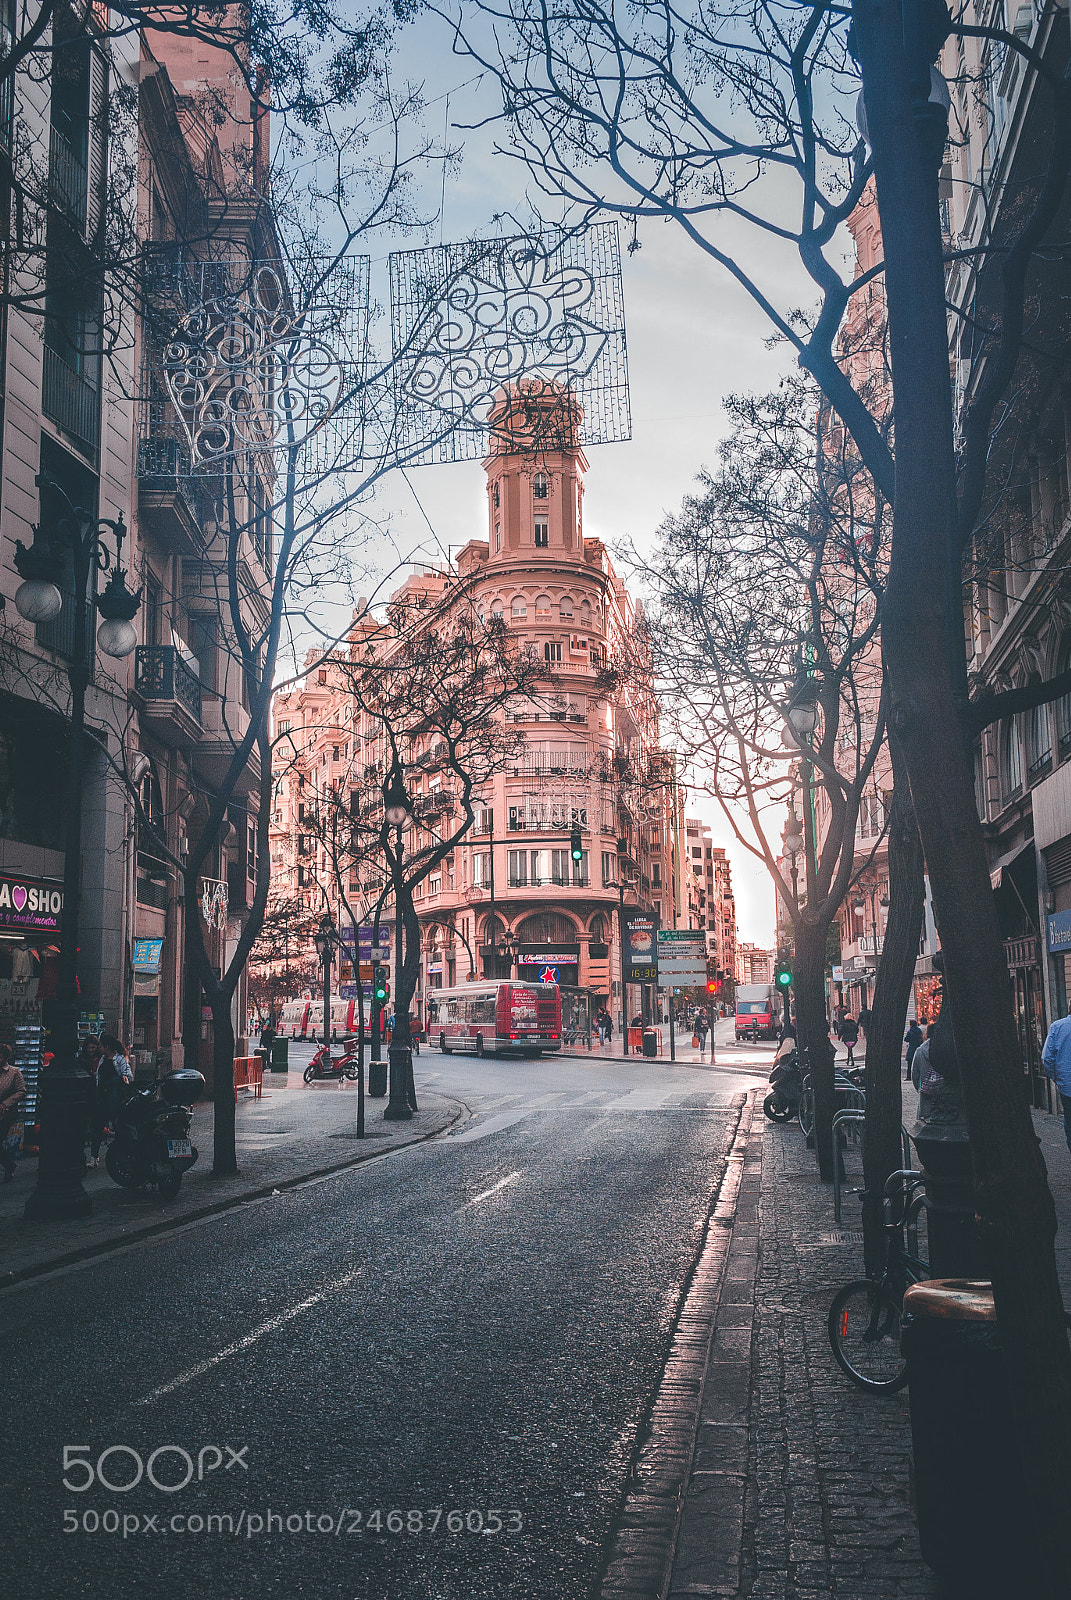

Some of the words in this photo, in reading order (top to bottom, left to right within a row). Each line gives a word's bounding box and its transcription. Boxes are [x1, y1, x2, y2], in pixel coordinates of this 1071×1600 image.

[28, 888, 64, 914] SHO
[13, 912, 56, 926] complementos
[632, 968, 656, 978] 16:30
